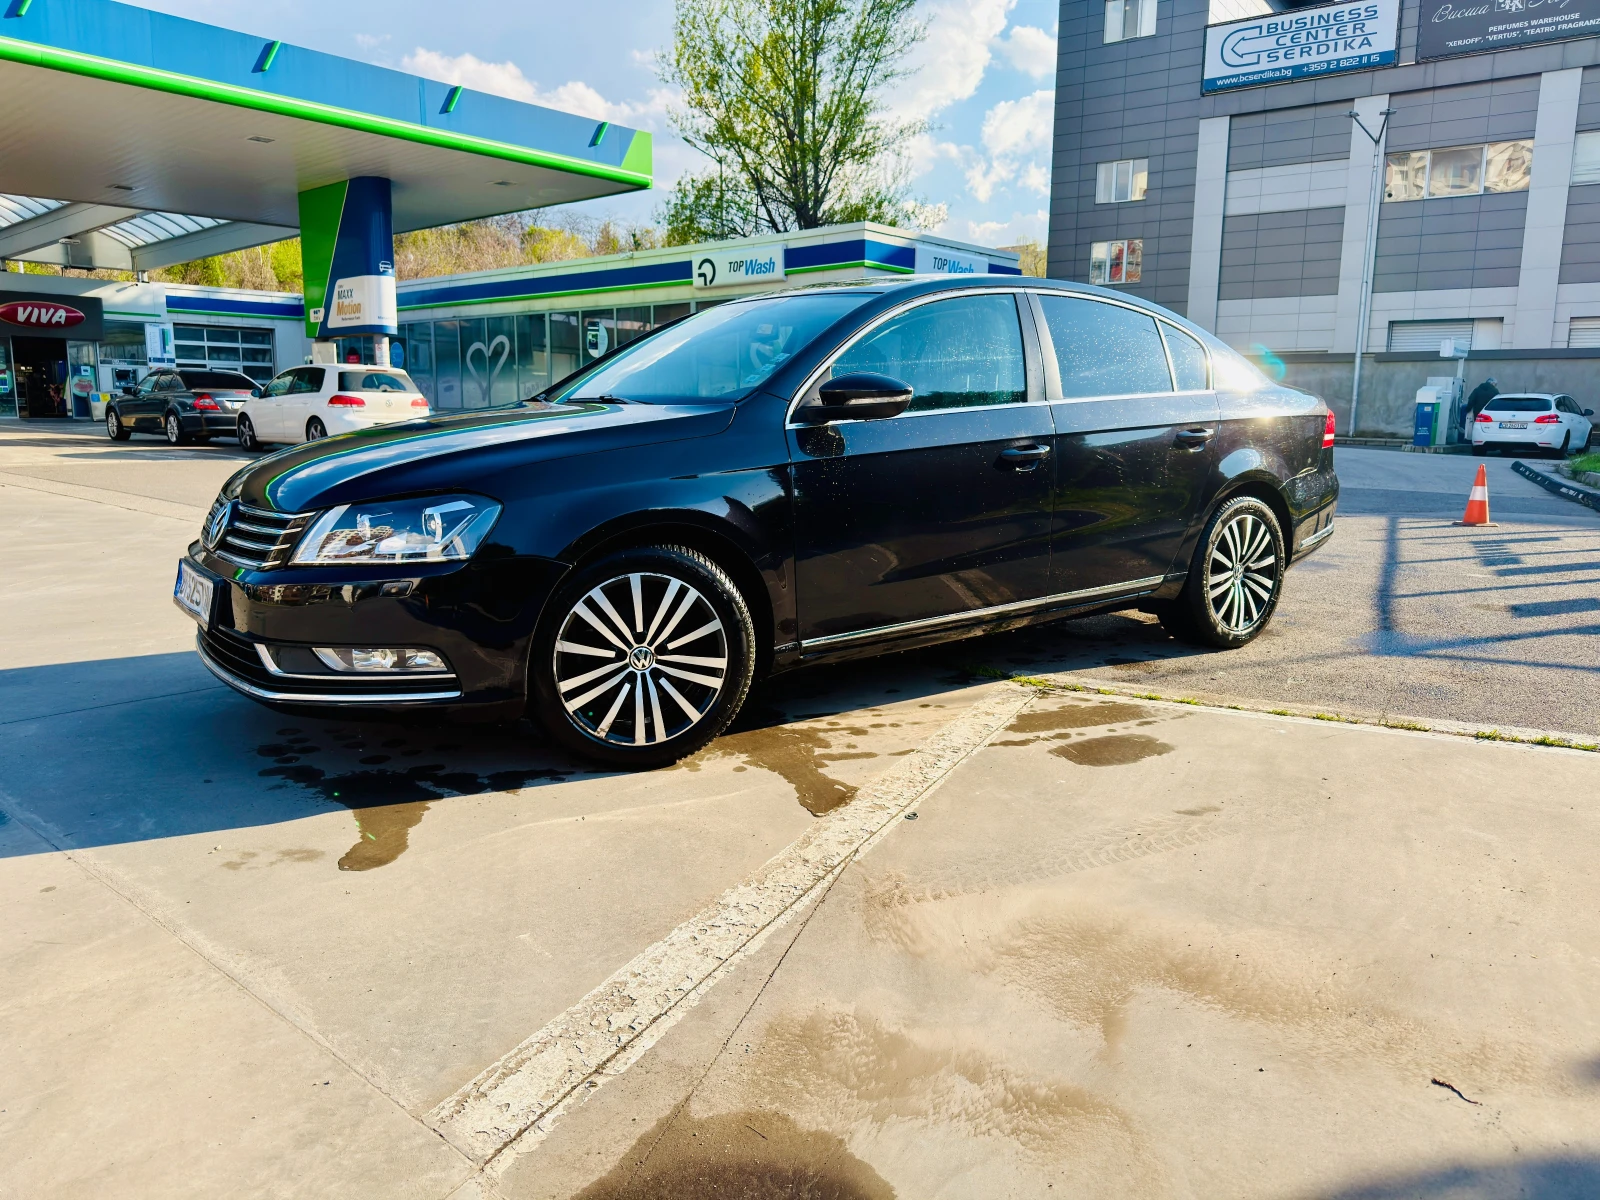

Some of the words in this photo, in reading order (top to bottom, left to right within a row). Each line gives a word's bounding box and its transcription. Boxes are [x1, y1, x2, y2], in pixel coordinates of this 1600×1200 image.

[1266, 5, 1378, 34] BUSINESS
[1488, 21, 1529, 33] PERFUMES
[1530, 13, 1581, 26] WAREHOUSE
[1276, 22, 1366, 47] CENTER
[1267, 36, 1373, 63] SERDIKA
[1216, 69, 1292, 86] www.bcserdika.bg
[1302, 62, 1327, 73] +359
[1330, 61, 1337, 69] 2
[1339, 58, 1359, 67] 822
[1370, 54, 1380, 62] 15
[338, 289, 354, 300] MAXX
[17, 306, 67, 325] VIVA
[337, 301, 362, 317] Motion
